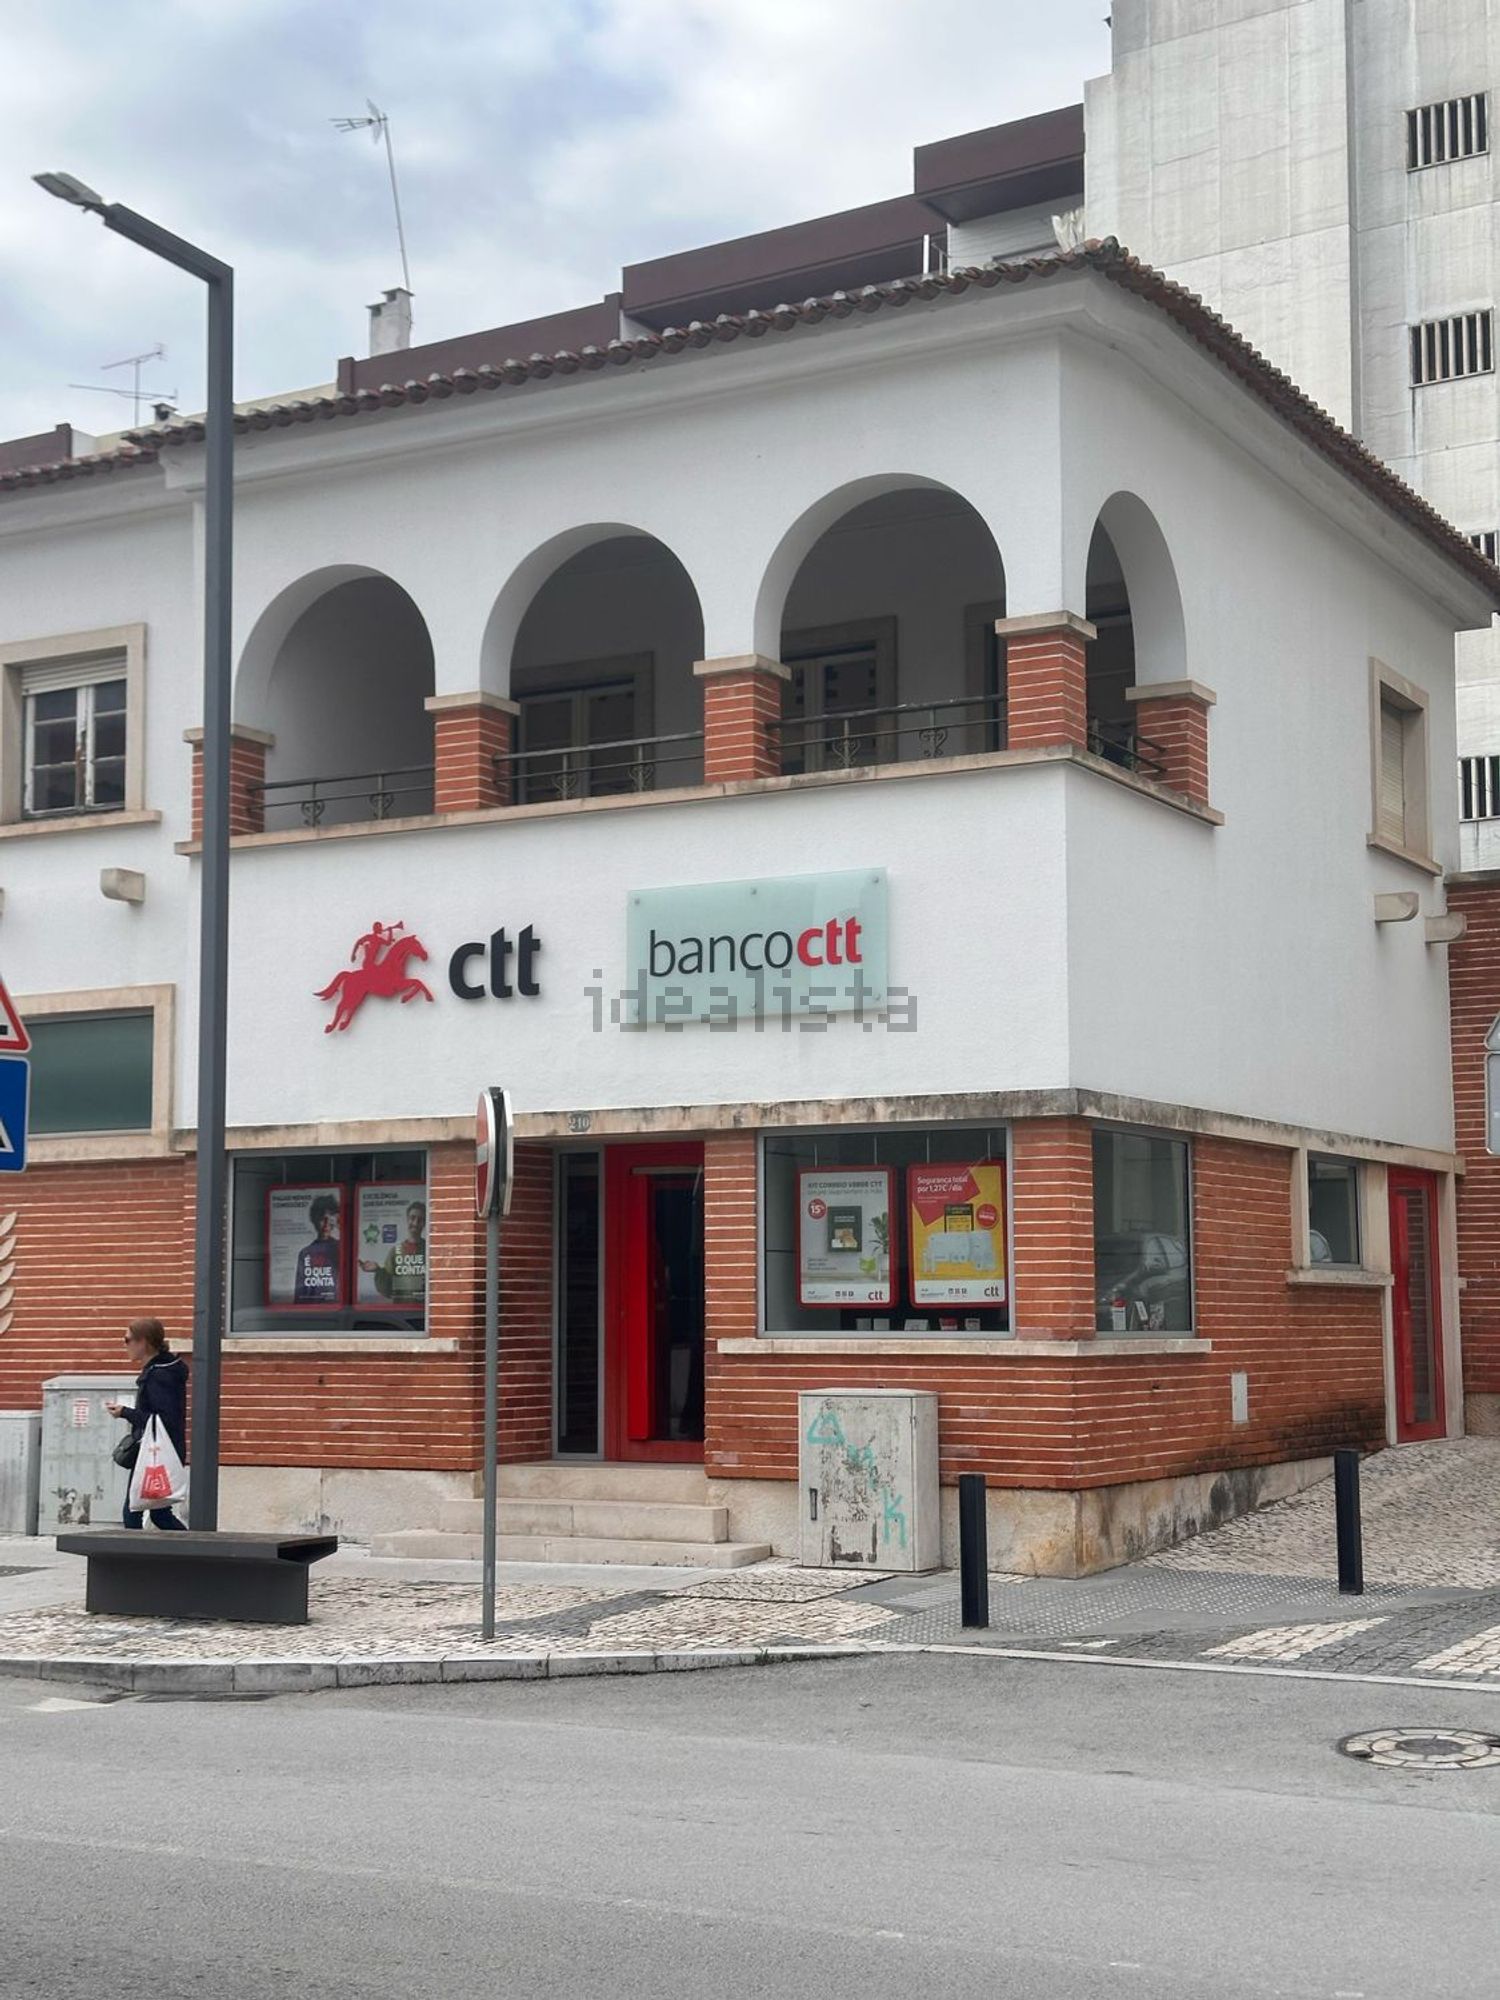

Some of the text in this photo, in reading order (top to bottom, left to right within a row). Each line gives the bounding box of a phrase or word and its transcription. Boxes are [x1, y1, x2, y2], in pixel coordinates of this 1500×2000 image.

[649, 916, 862, 977] bancoctt
[449, 923, 541, 999] ctt
[395, 1254, 424, 1265] O QUE
[304, 1266, 332, 1277] O QUE
[395, 1265, 425, 1275] CONTA
[304, 1277, 335, 1287] CONTA
[868, 1290, 883, 1301] ctt
[984, 1286, 999, 1297] ctt
